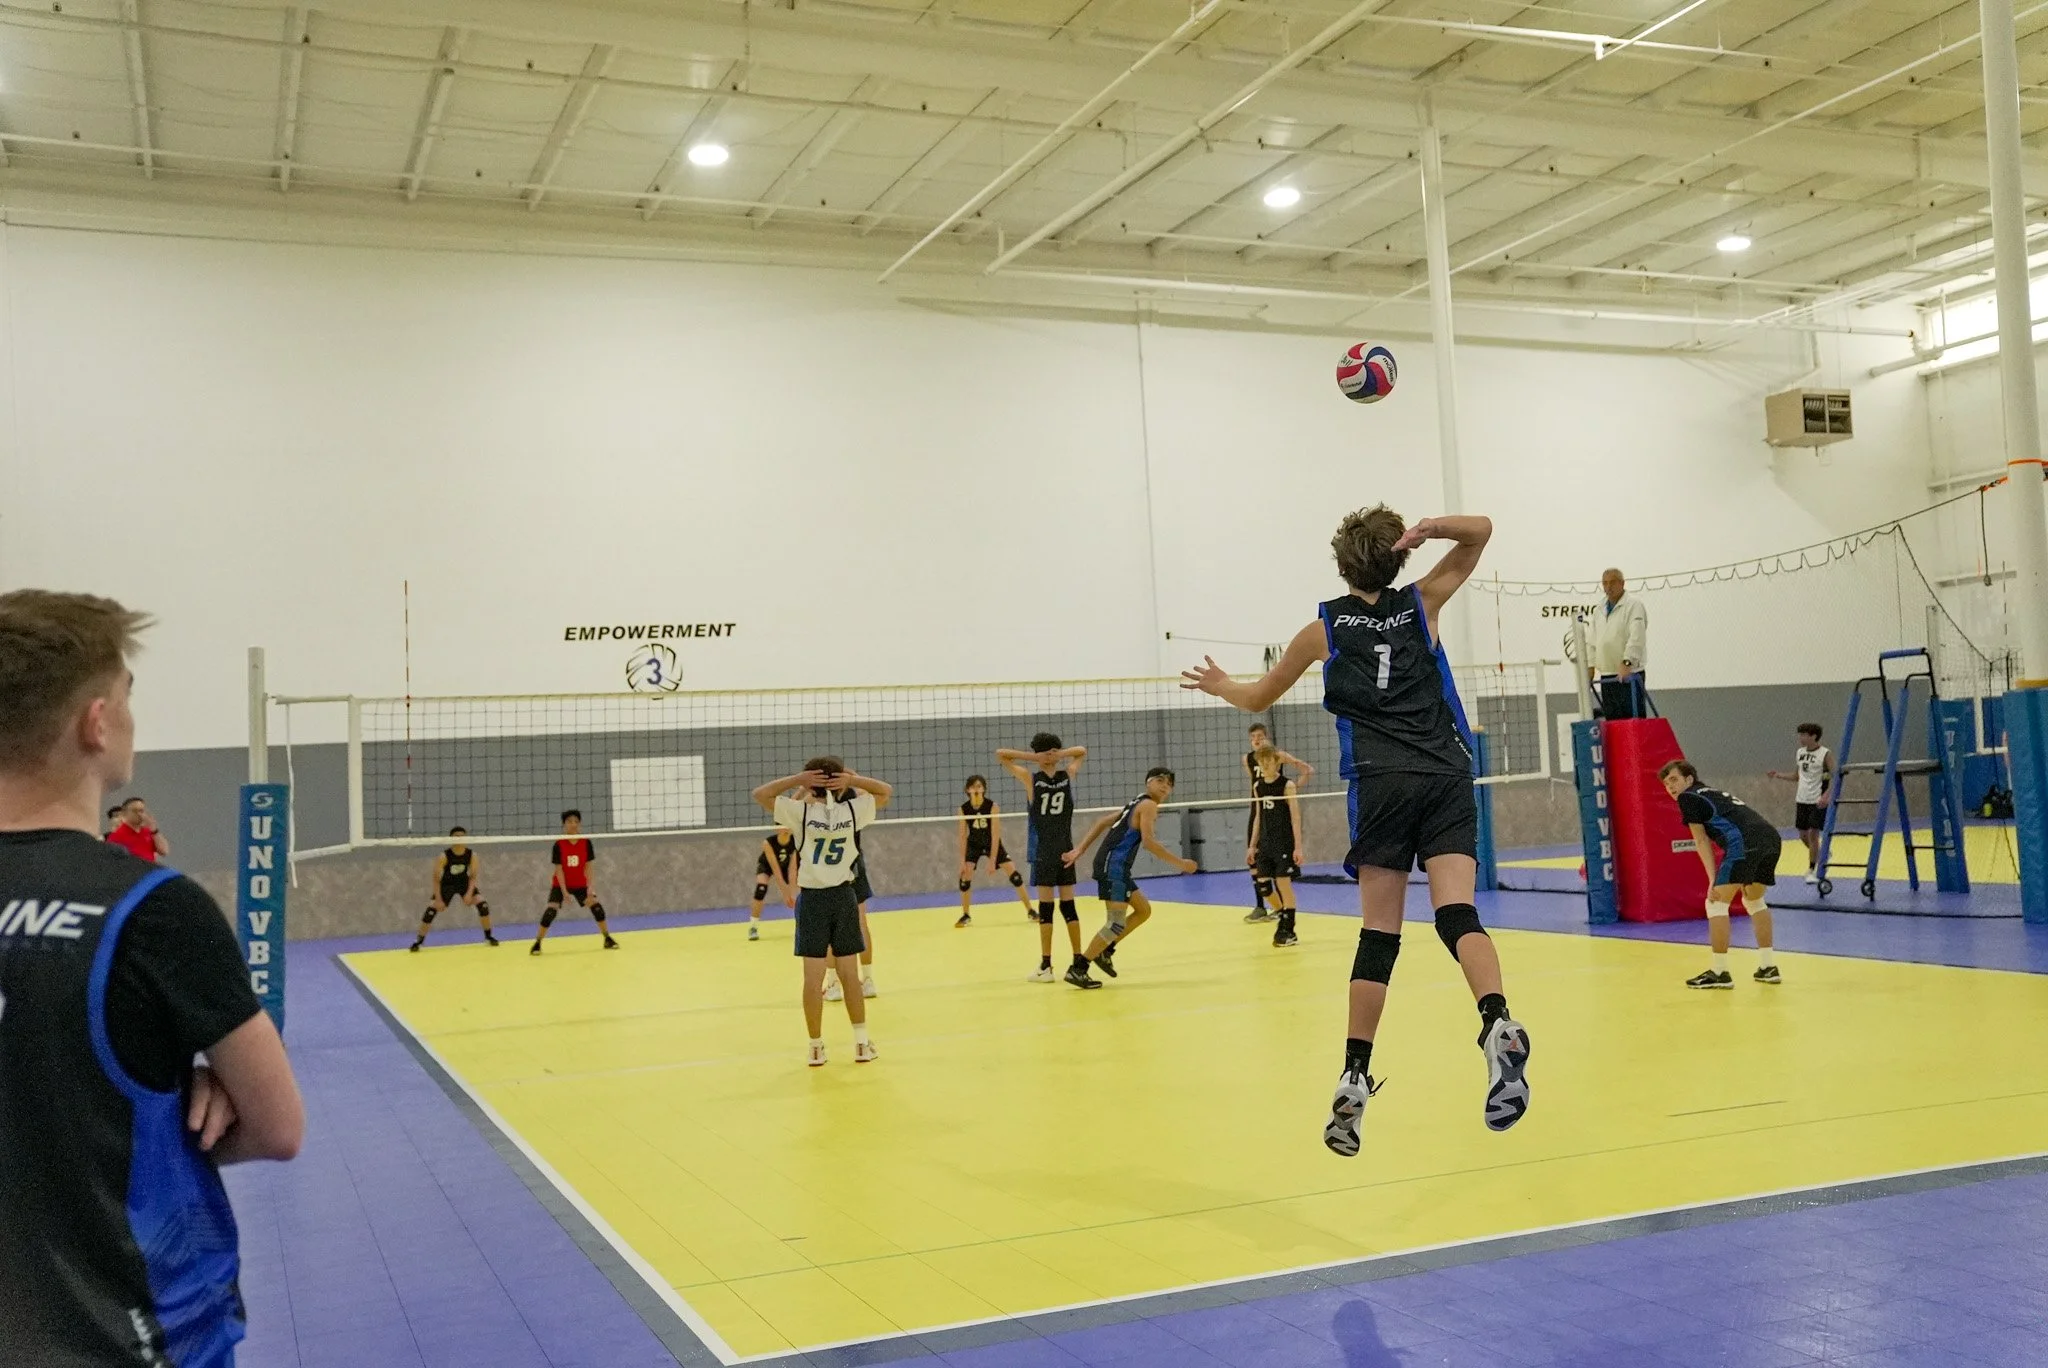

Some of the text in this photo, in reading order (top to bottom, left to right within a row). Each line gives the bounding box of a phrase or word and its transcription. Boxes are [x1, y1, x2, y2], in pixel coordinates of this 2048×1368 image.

[564, 623, 737, 641] EMPOWERMENT
[646, 657, 662, 685] 3
[1374, 643, 1392, 689] 1
[1040, 791, 1066, 816] 19
[812, 837, 848, 866] 15
